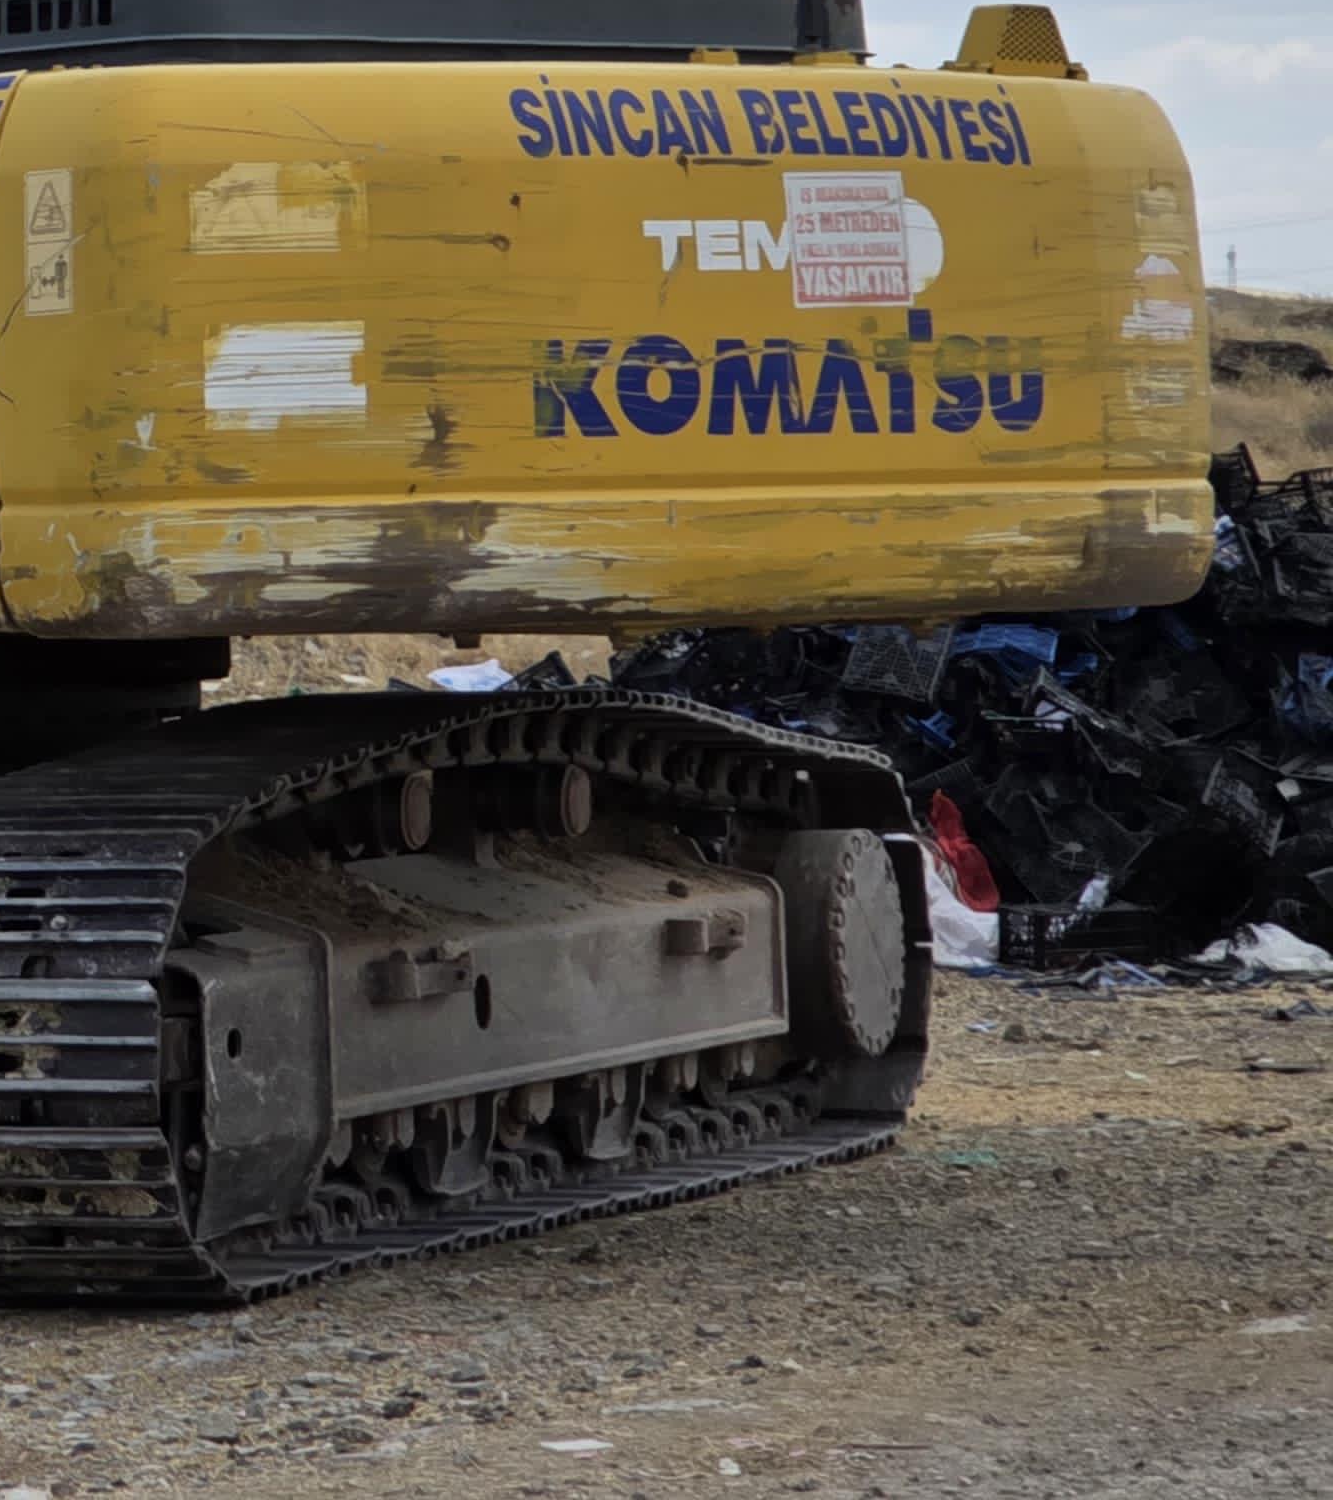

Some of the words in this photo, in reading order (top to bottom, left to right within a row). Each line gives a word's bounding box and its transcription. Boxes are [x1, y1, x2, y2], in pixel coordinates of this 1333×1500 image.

[509, 74, 732, 158] SİNCAN
[737, 78, 1031, 166] BELEDİYESİ
[796, 212, 815, 234] 25
[800, 265, 906, 297] YASAKTIR
[533, 308, 1044, 437] KOMATSU
